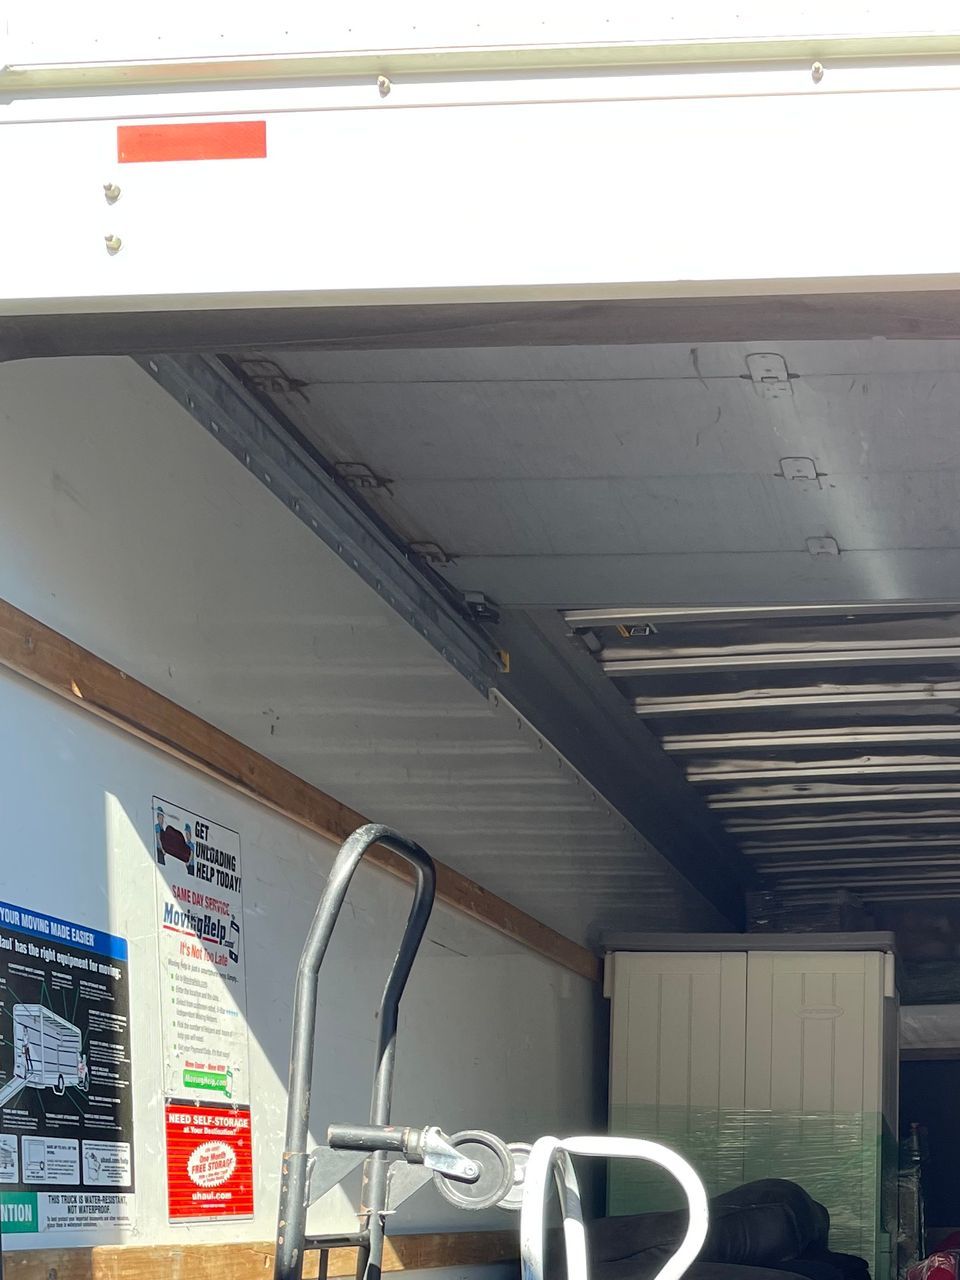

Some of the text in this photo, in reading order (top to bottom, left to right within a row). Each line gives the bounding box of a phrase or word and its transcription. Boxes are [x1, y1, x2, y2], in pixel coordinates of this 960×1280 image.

[195, 820, 209, 841] GET
[195, 841, 236, 872] UNLOADING
[196, 862, 241, 893] HELP TODAY!
[172, 885, 230, 916] SAME DAY SERVICE
[0, 907, 95, 947] YOUR MOVING MADE EASIER
[15, 939, 27, 954] has
[28, 942, 39, 957] the
[40, 946, 56, 962] right
[57, 953, 88, 970] equipment
[89, 959, 98, 972] for
[179, 941, 228, 967] It's Not Too Late
[169, 1114, 248, 1127] NEED SELF-STORAGE
[192, 1164, 206, 1174] FREE
[48, 1195, 60, 1204] THIS
[61, 1195, 77, 1204] TRUCK
[192, 1192, 232, 1200] uhaul.com
[68, 1205, 77, 1214] NOT
